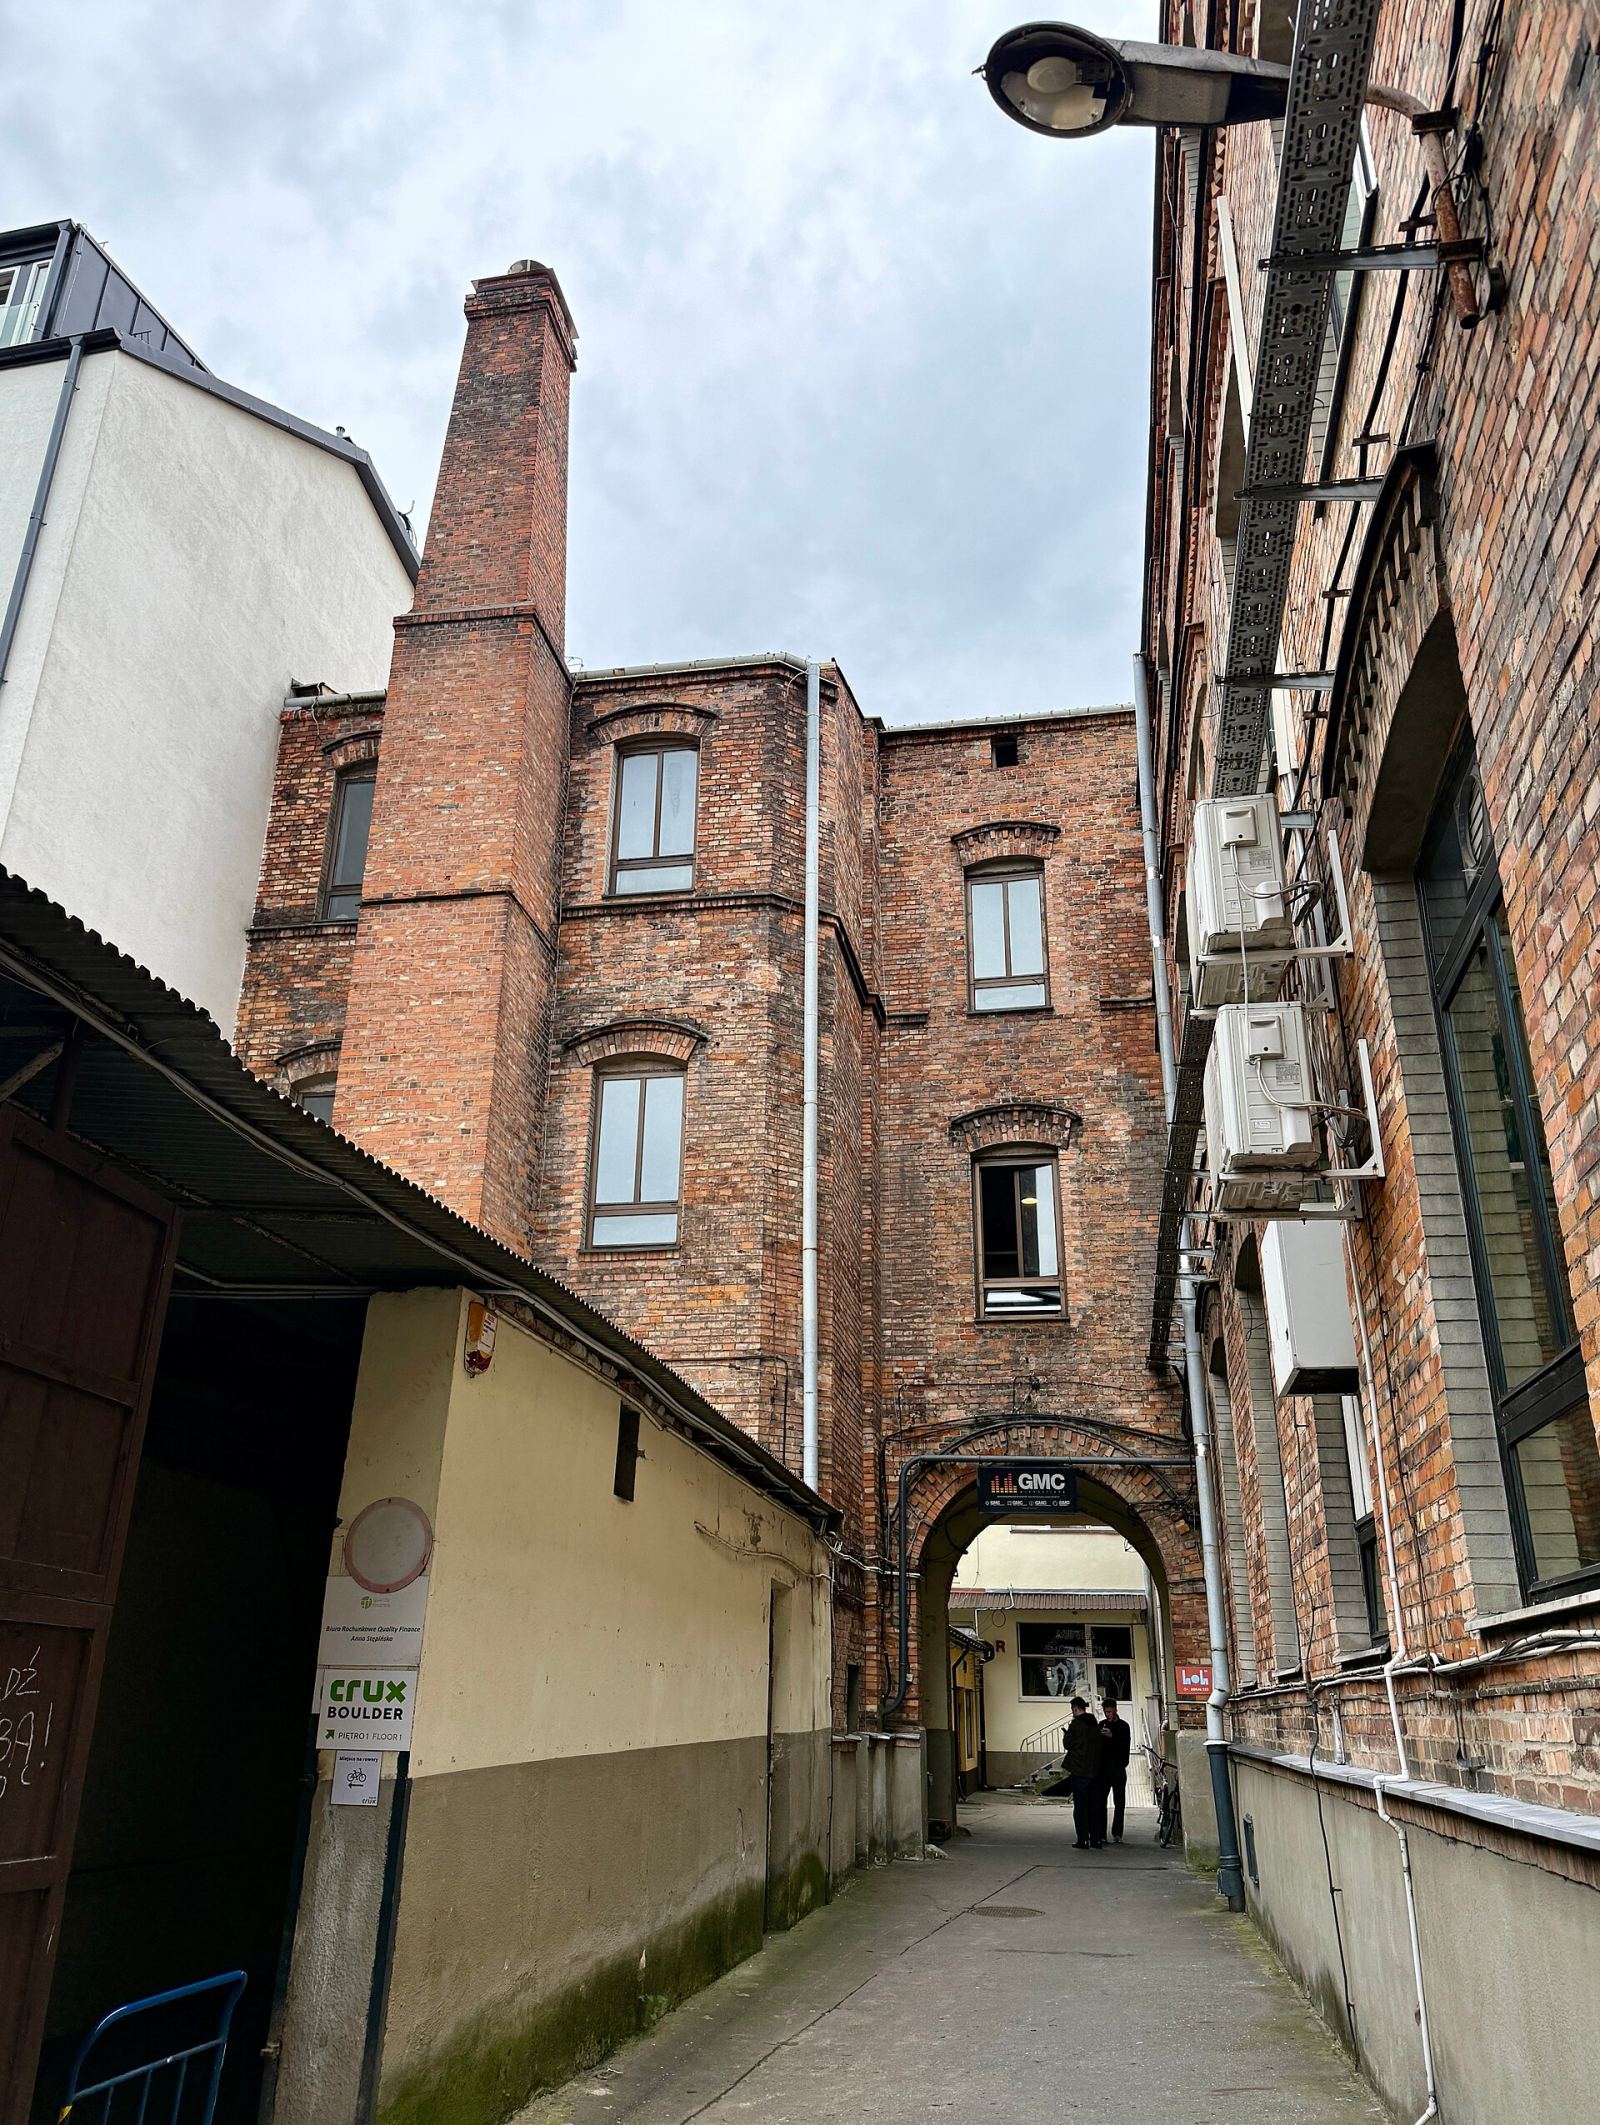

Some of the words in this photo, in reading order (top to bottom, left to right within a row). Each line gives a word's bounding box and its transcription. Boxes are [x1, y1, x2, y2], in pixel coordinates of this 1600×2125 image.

[1018, 1473, 1066, 1490] GMC
[330, 1679, 408, 1704] crux
[327, 1706, 403, 1720] BOULDER
[338, 1732, 365, 1741] PIĘTRO
[372, 1733, 398, 1741] FLOOR
